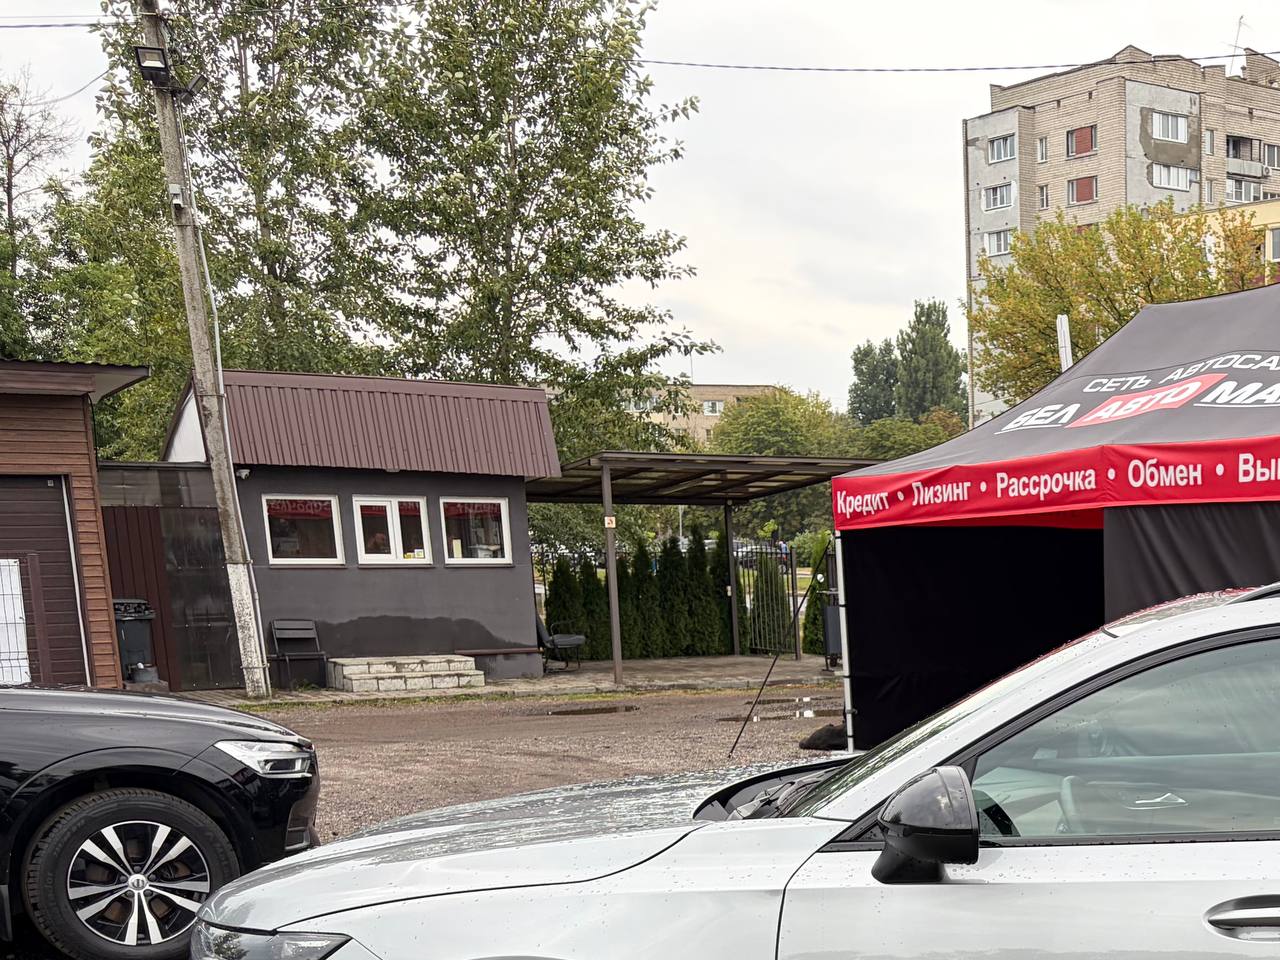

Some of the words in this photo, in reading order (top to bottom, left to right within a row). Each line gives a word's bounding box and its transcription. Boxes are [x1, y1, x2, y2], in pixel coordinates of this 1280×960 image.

[1001, 403, 1081, 432] БЕЛ
[1083, 381, 1202, 423] АВТО
[1083, 376, 1152, 393] СЕТЬ
[836, 490, 890, 518] Кредит
[912, 481, 972, 507] Лизинг
[996, 468, 1096, 501] Рассрочка
[1127, 458, 1202, 488] Обмен
